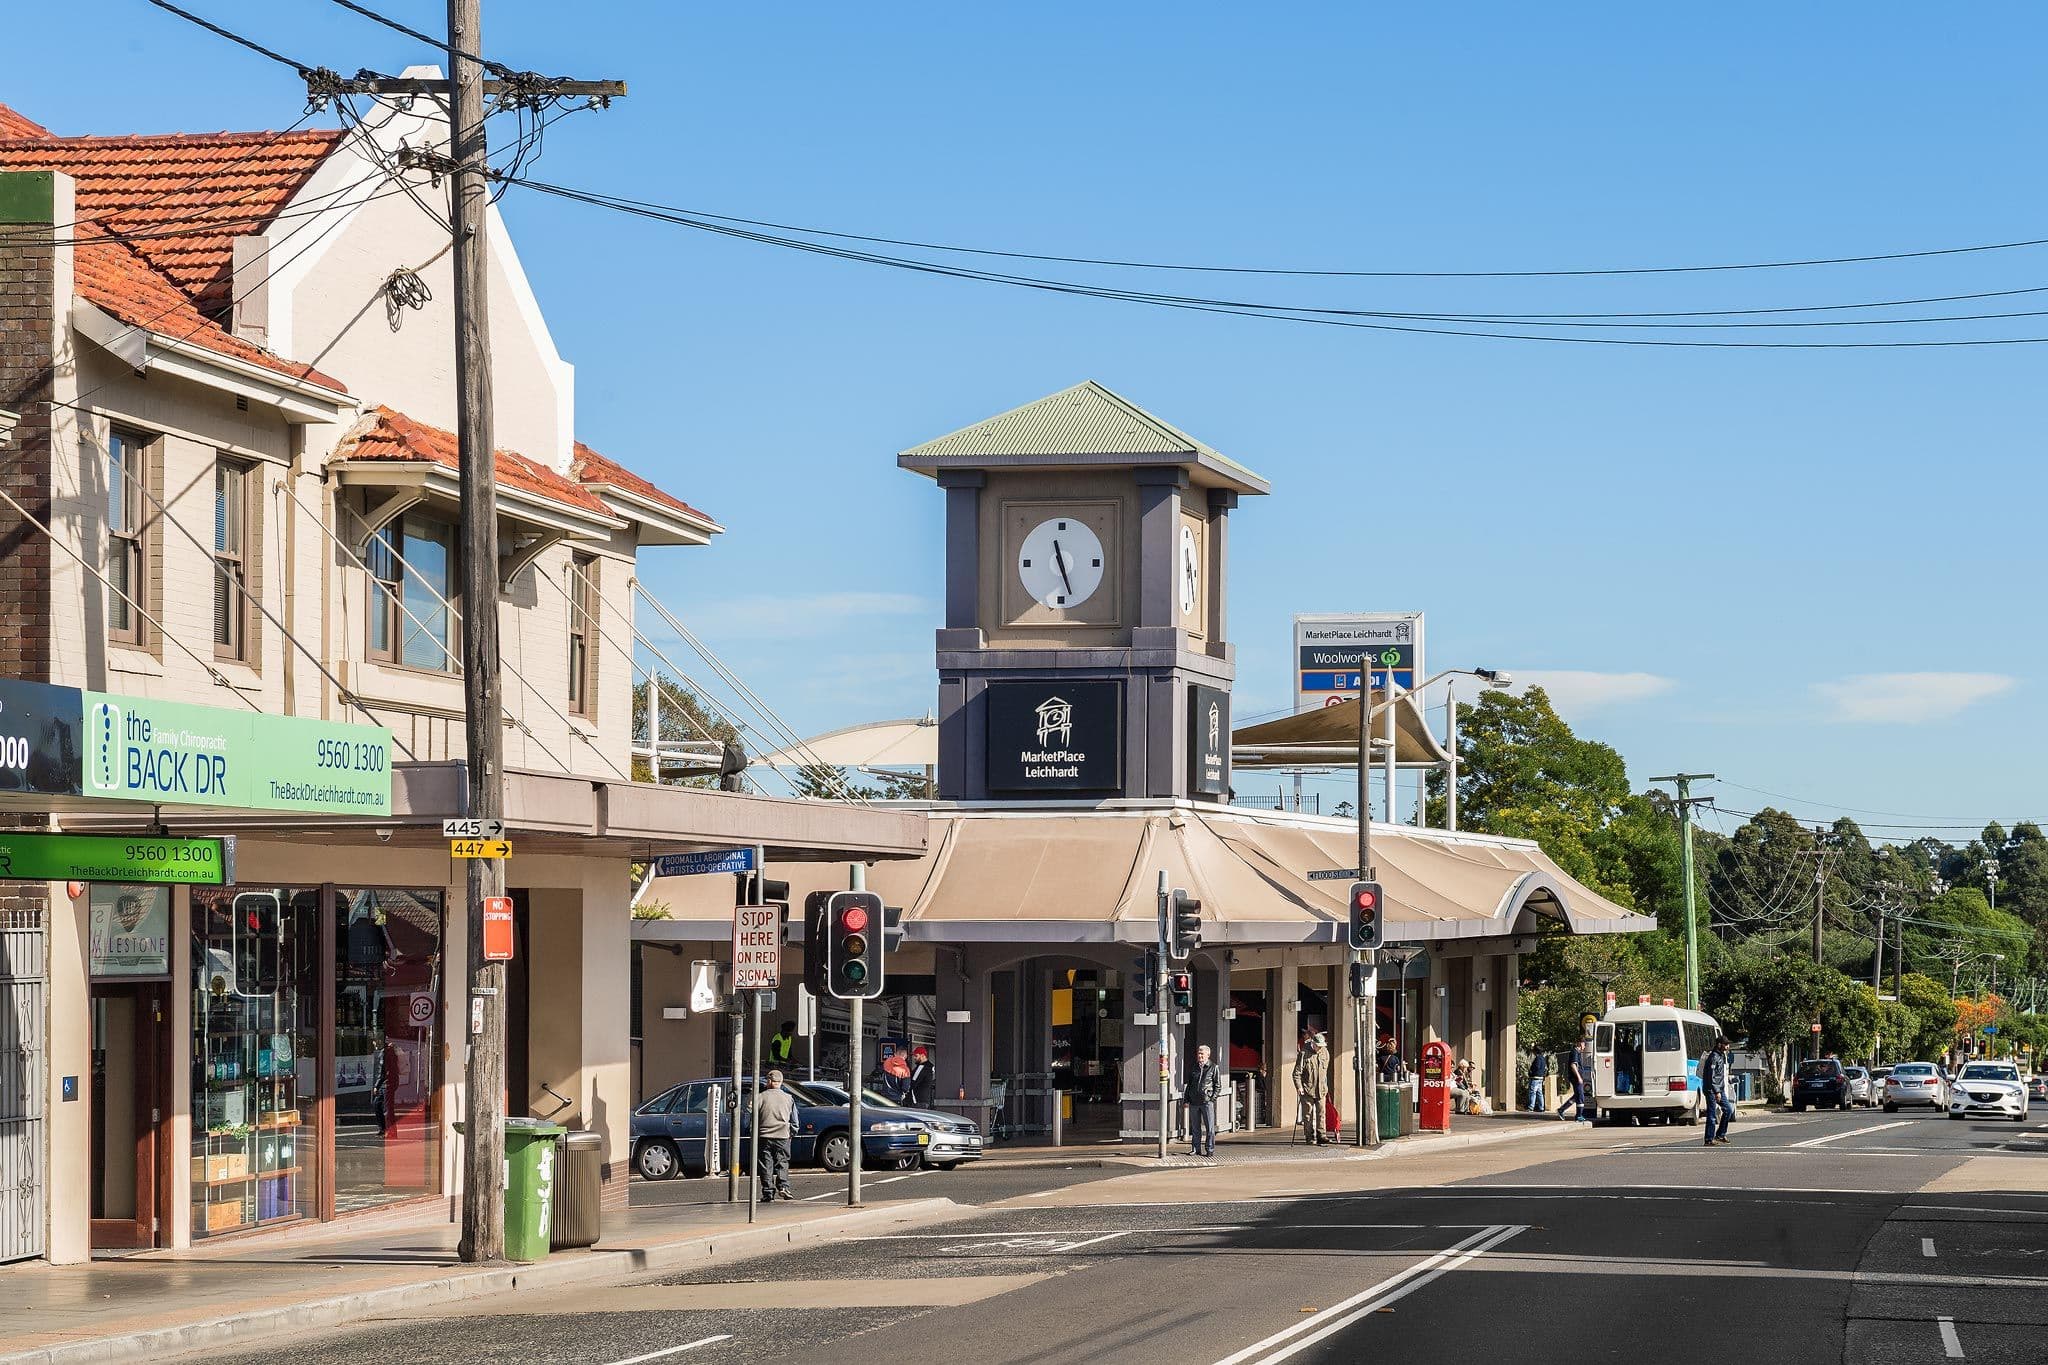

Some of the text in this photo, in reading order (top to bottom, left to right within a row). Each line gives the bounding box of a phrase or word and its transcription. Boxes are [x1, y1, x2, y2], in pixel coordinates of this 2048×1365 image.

[1305, 629, 1392, 639] MarketPlace Leichhardt
[1353, 676, 1379, 686] ADI
[127, 710, 151, 742] the
[153, 728, 226, 751] Family Chiropractic
[317, 739, 384, 772] 9560 1300
[1021, 750, 1085, 762] MarketPlace
[127, 747, 226, 795] BACK DR
[1025, 766, 1079, 778] Leichhardt
[270, 780, 384, 806] TheBackDrLeichhardt.com.au
[445, 820, 482, 835] 445
[125, 845, 213, 862] 9560 1300
[454, 842, 485, 855] 447
[665, 851, 746, 866] BOOMALLI ABORIGINAL
[70, 865, 214, 879] TheBackDrLeichhardt.com.au
[665, 860, 747, 875] ARTISTS CO-OPERATIVE
[492, 900, 504, 910] NO
[741, 912, 774, 926] STOP
[740, 932, 774, 946] HERE
[737, 951, 776, 964] ON RED
[738, 969, 775, 982] SIGNAL
[1423, 1080, 1444, 1088] POST
